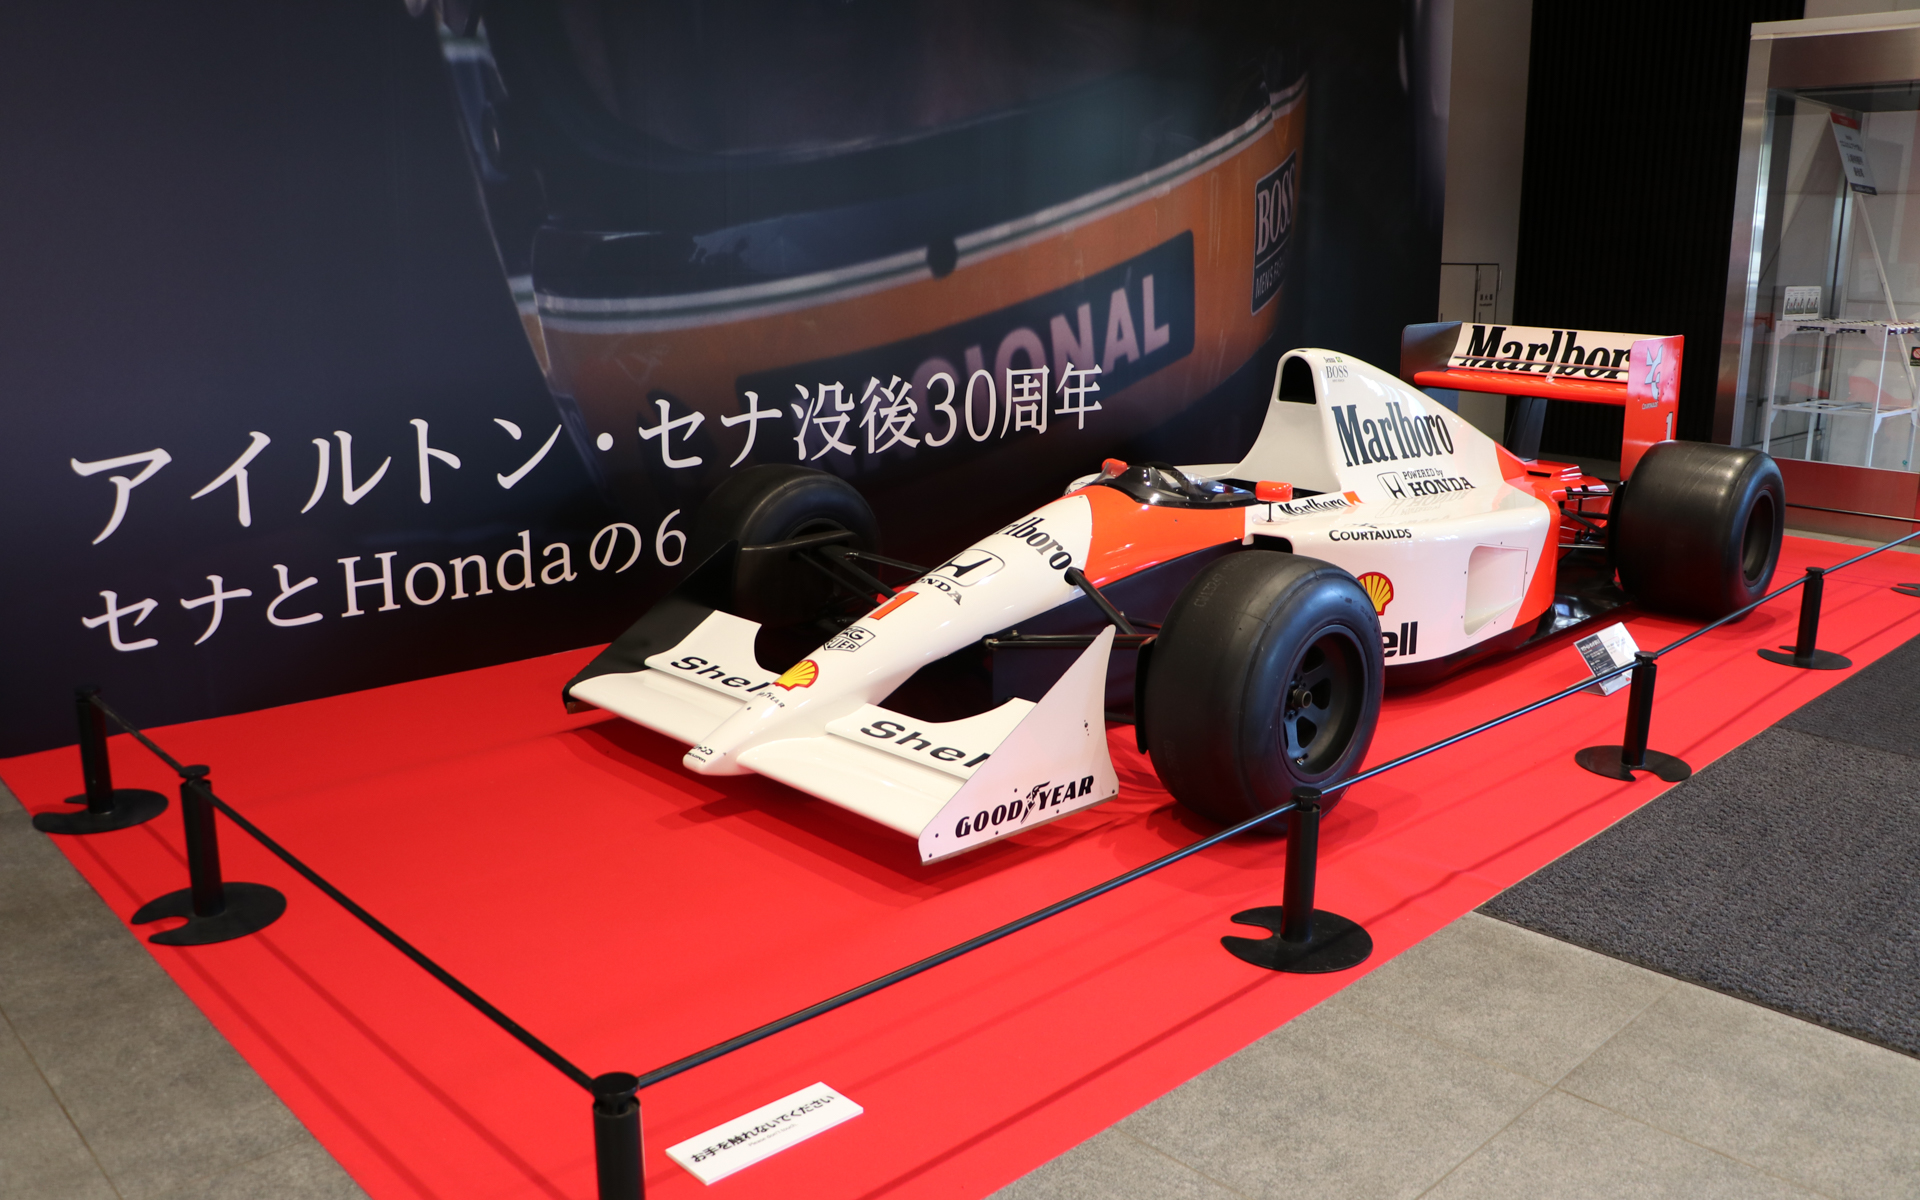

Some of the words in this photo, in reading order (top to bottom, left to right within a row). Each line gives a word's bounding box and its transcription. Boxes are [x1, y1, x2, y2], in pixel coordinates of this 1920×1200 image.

[1256, 162, 1295, 256] BOSS
[1325, 365, 1349, 379] BOSS
[1459, 325, 1631, 379] Marlbor
[70, 362, 1103, 546] アイルトン・セナ没後30周年
[1331, 402, 1454, 467] Marlboro
[1402, 468, 1435, 480] POWERED
[1435, 468, 1444, 478] by
[1407, 476, 1476, 497] HONDA
[1329, 527, 1412, 542] COURTAULDS
[868, 591, 919, 622] 1
[670, 656, 771, 693] Shel
[860, 720, 991, 768] Shel
[691, 1094, 835, 1164] お手を触れないでください
